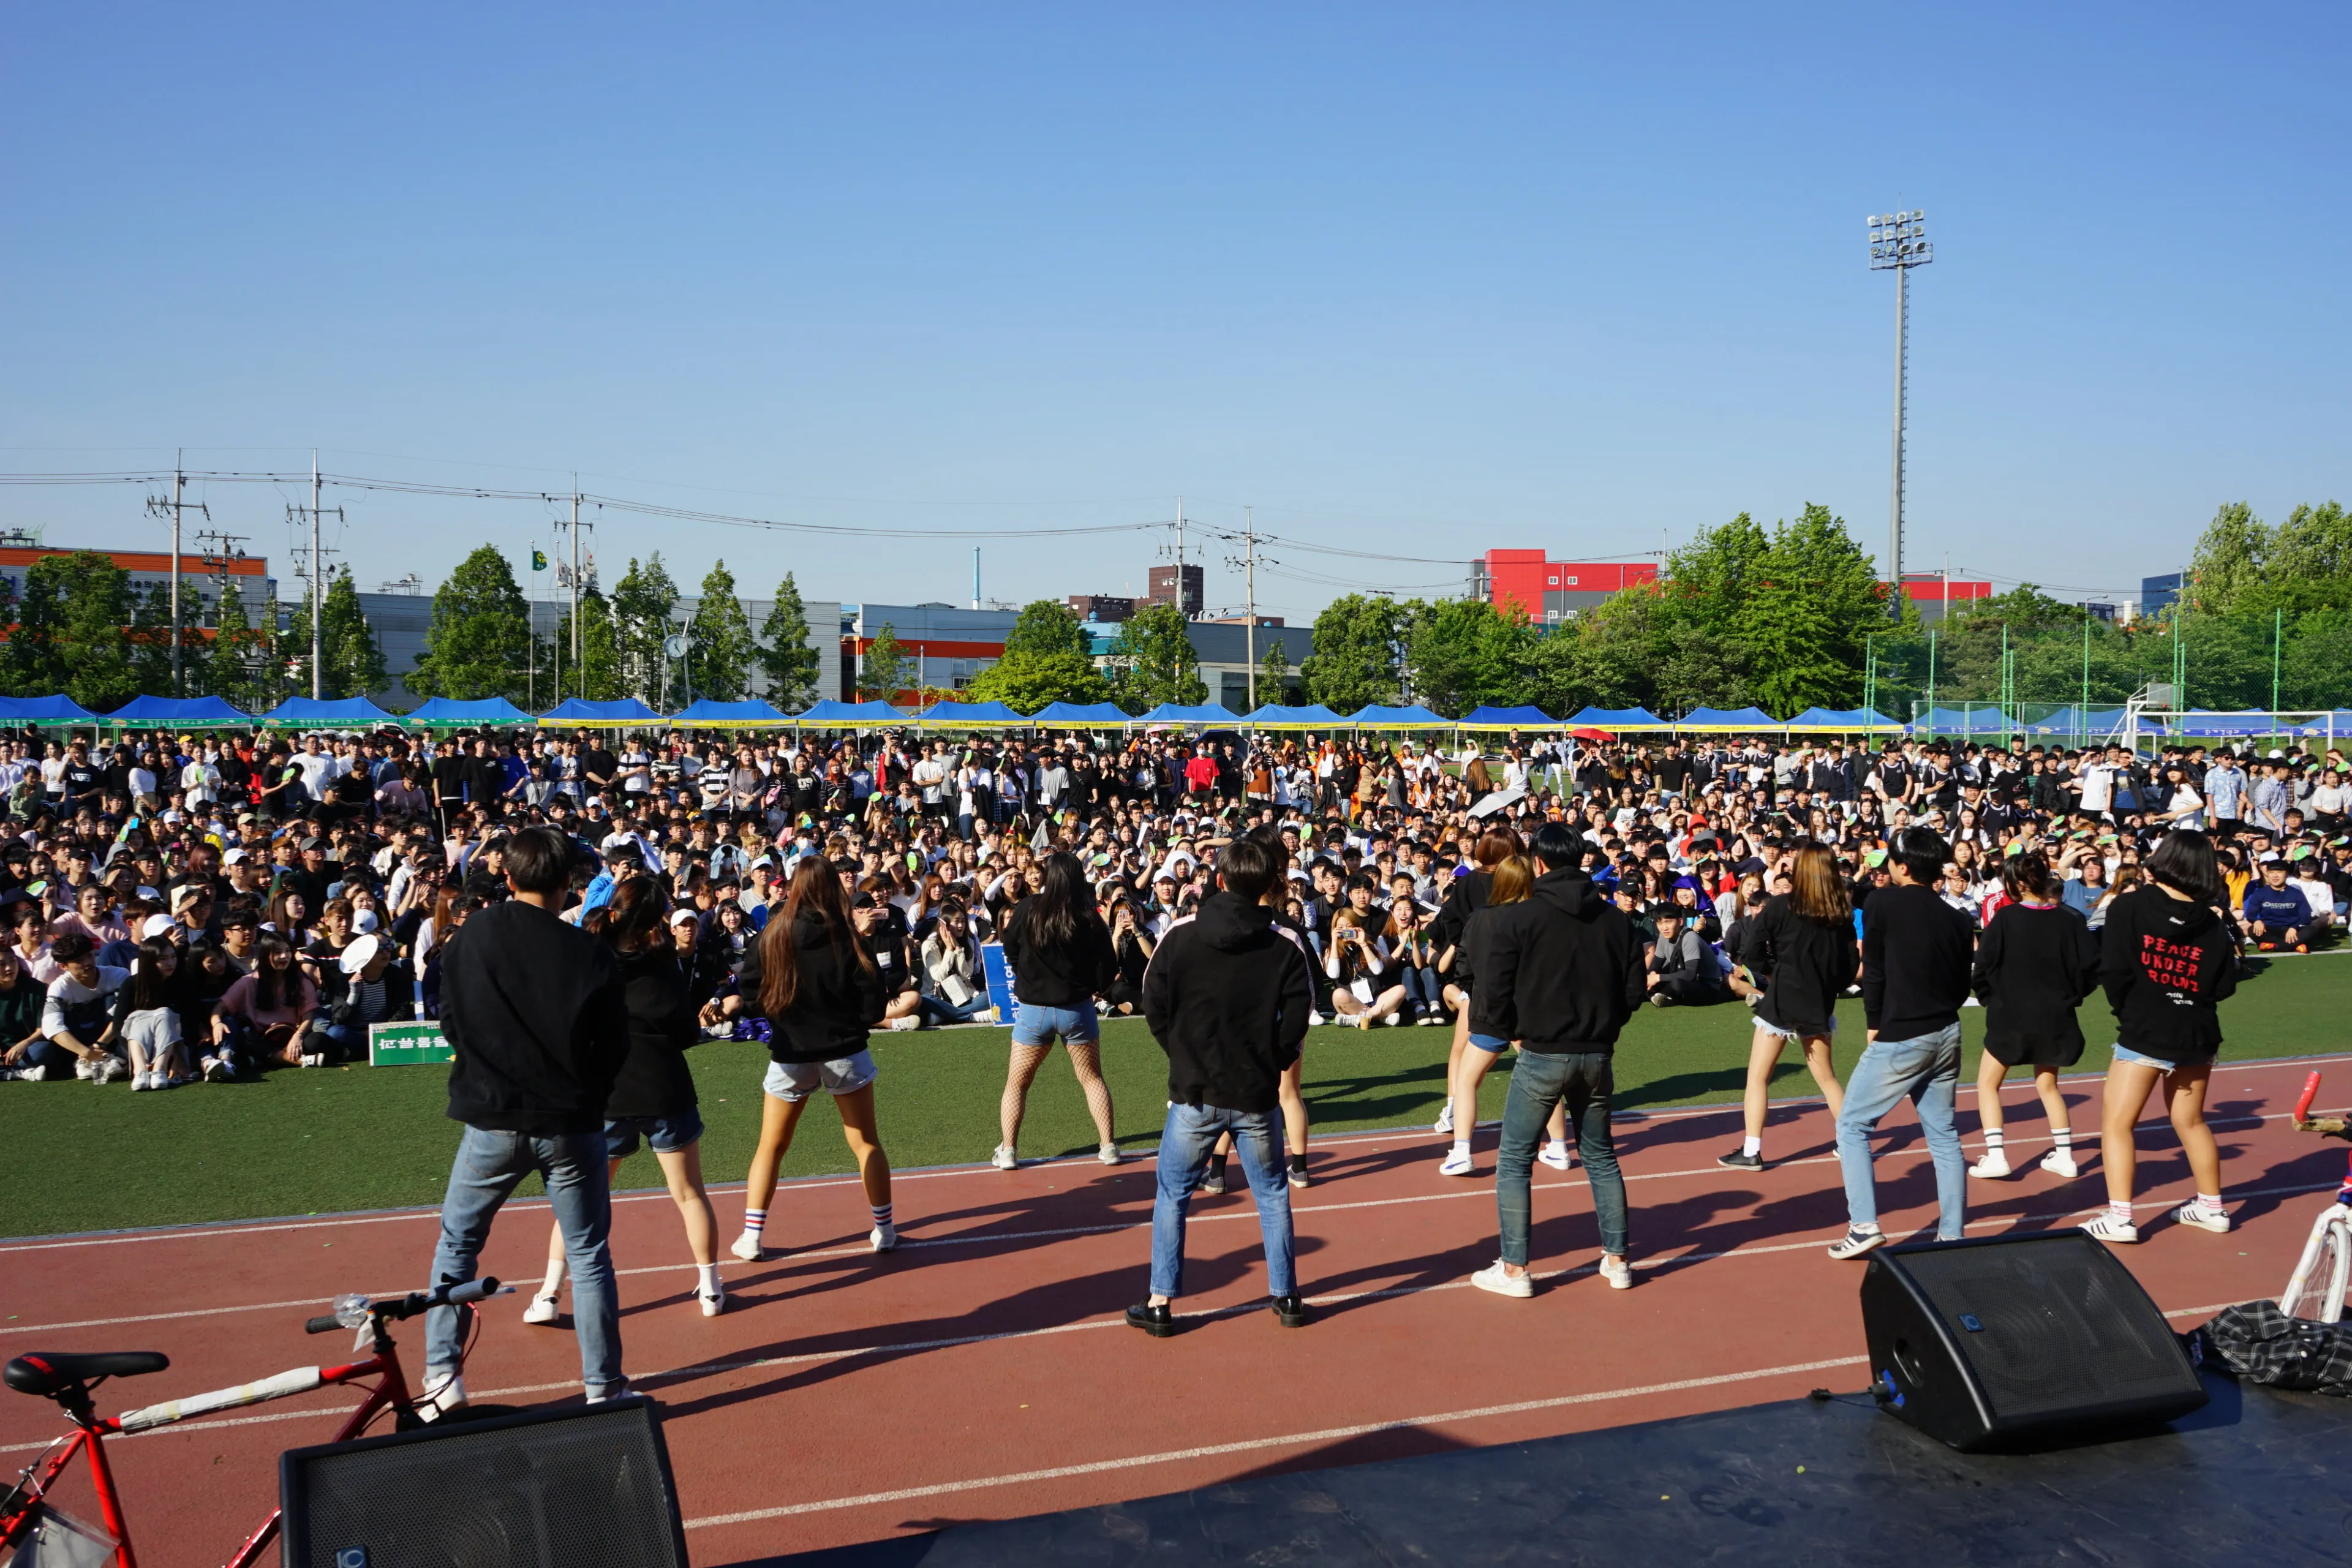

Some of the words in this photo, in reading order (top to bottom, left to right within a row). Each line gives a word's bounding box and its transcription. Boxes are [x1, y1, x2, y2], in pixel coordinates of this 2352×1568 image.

[2143, 935, 2203, 961] PEACE
[2141, 951, 2198, 977] UNDER
[378, 1036, 448, 1050] 통물류과
